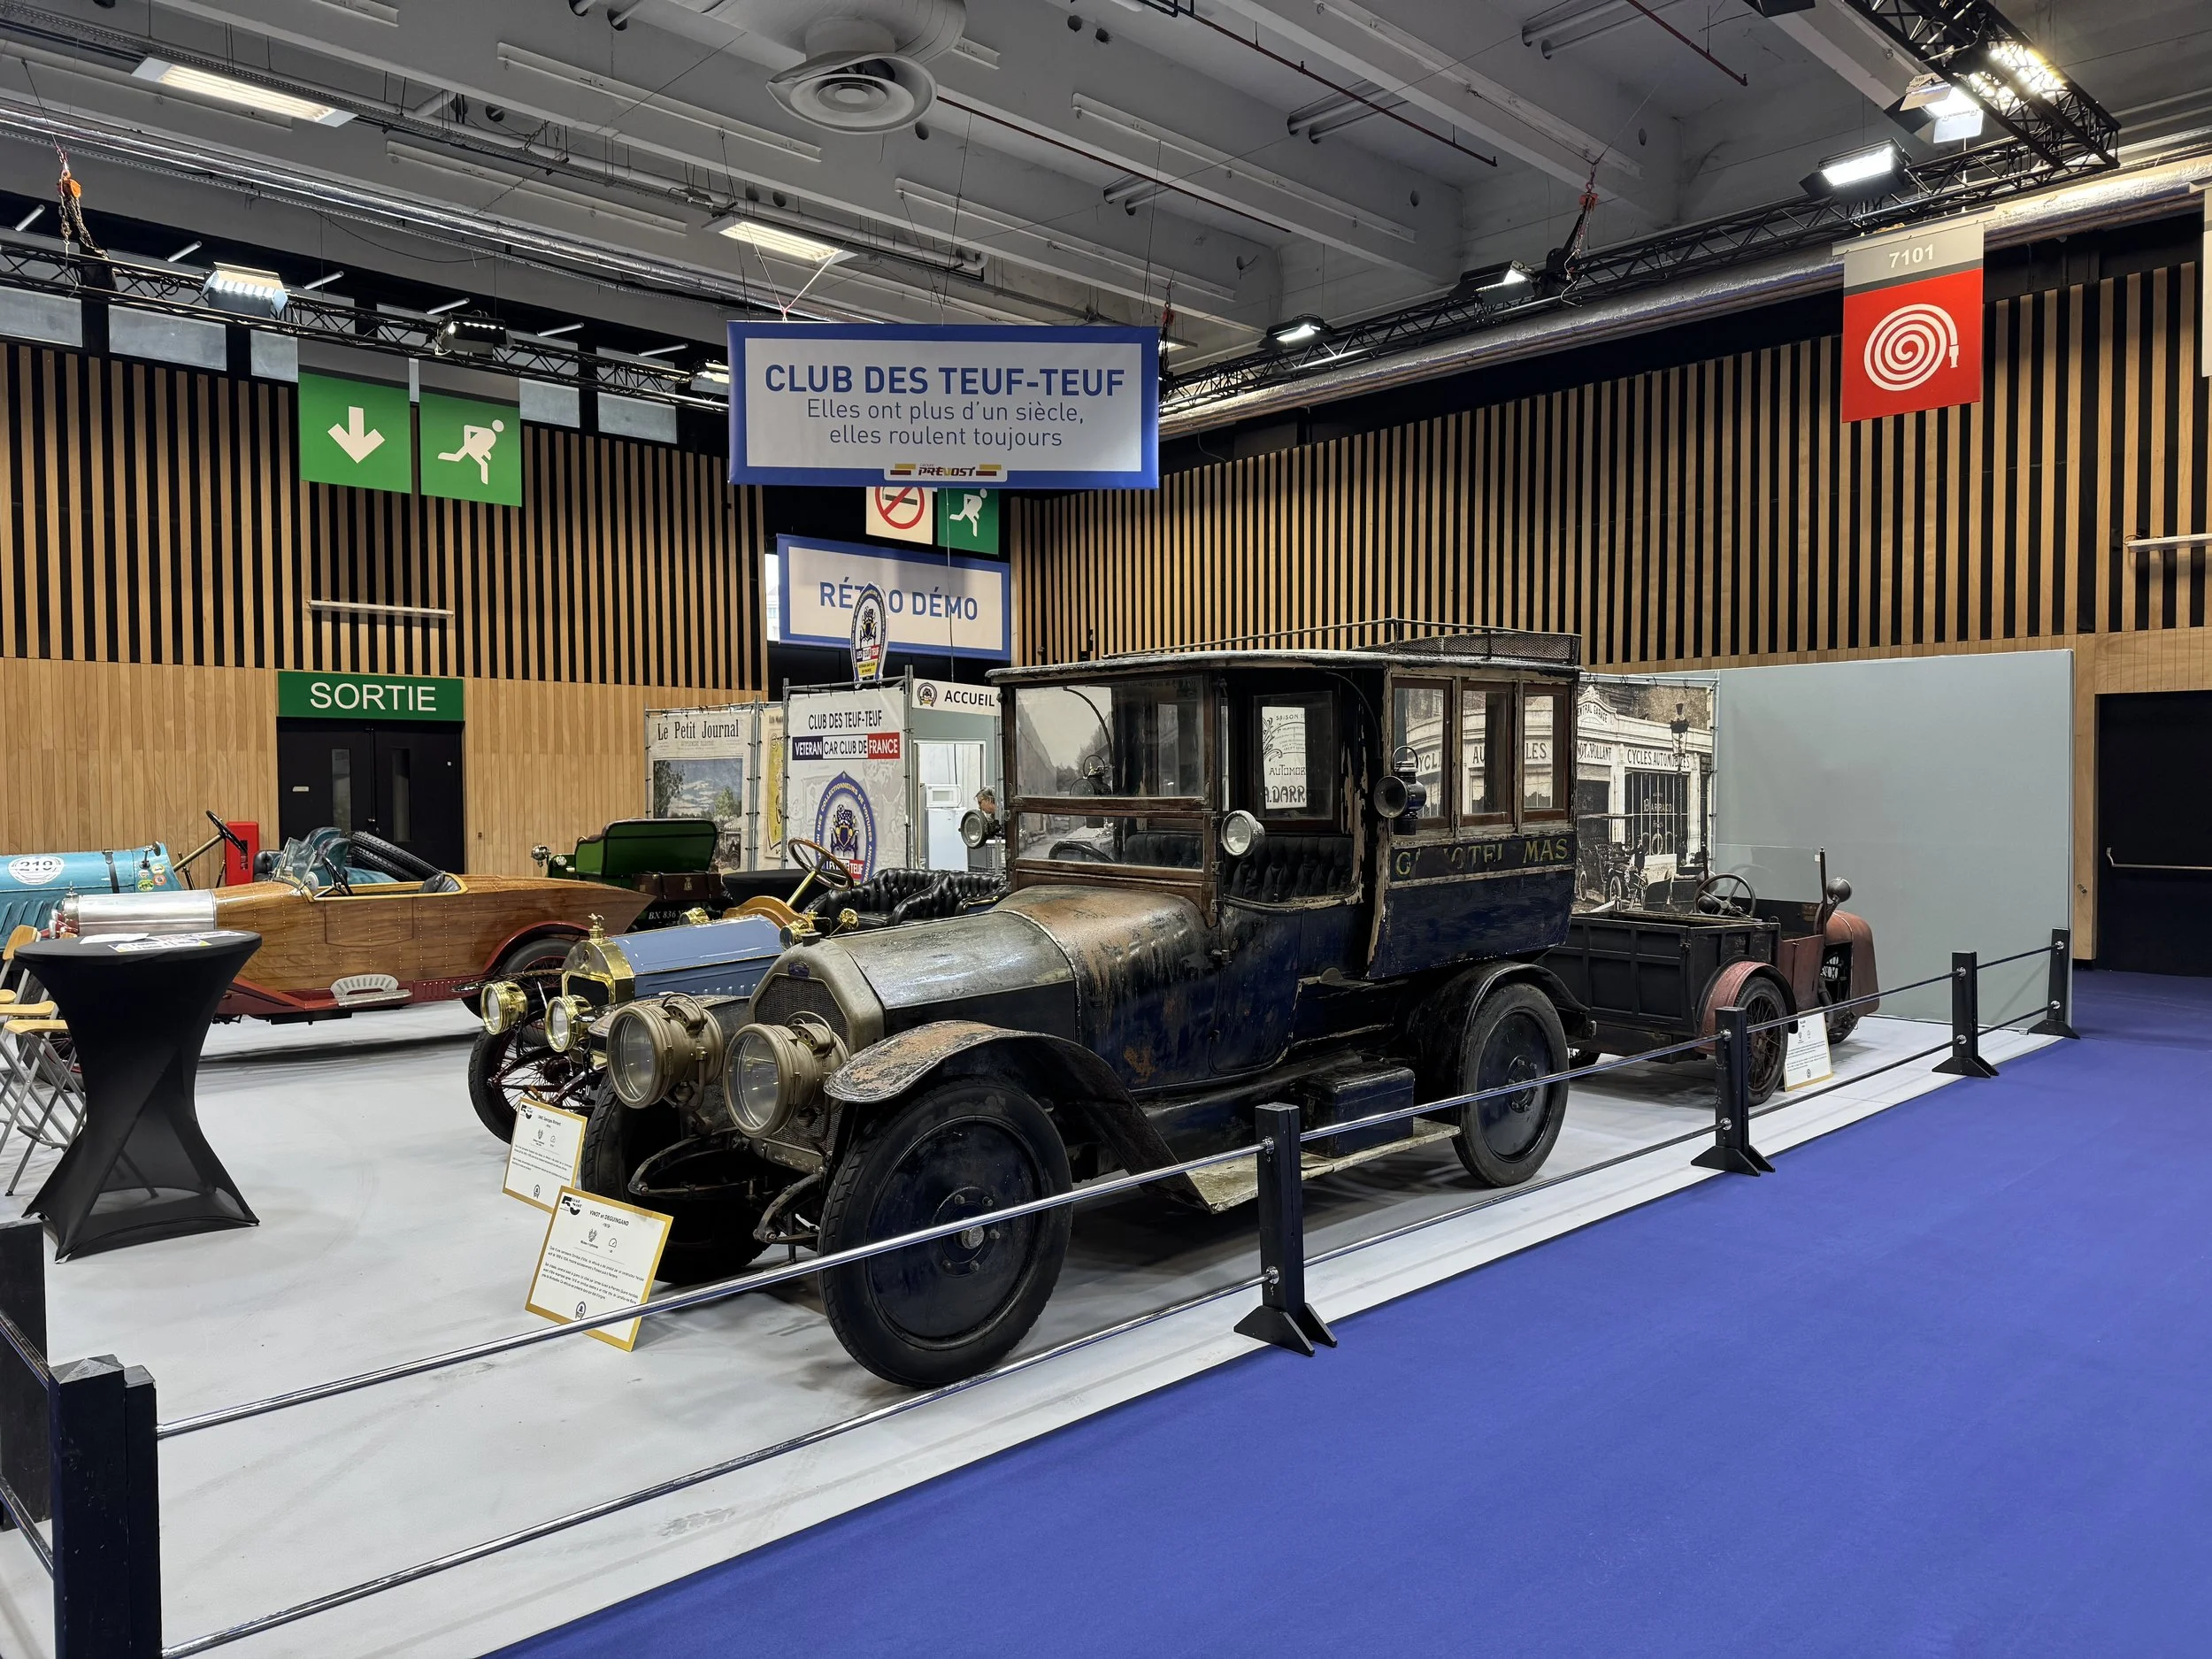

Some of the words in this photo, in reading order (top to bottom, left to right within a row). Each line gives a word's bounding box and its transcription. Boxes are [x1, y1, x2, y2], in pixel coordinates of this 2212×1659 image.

[1889, 244, 1934, 269] 7101
[765, 365, 853, 393] CLUB
[865, 366, 927, 395] DES
[938, 368, 1125, 396] TEUF-TEUF
[808, 399, 860, 419] Elles
[868, 403, 902, 419] ont
[910, 402, 955, 425] plus
[963, 401, 1009, 421] d'un
[1016, 402, 1084, 425] siècle,
[830, 426, 881, 444] elles
[890, 426, 966, 446] roulent
[973, 427, 1062, 451] toujours
[819, 577, 903, 613] RÉO
[912, 587, 978, 620] DÉMO
[310, 682, 437, 711] SORTIE
[945, 690, 995, 707] ACCUEIL
[658, 723, 669, 740] Le
[674, 721, 695, 739] Petit
[702, 718, 739, 739] Journal
[809, 714, 826, 730] CLUB
[829, 713, 842, 729] DES
[846, 710, 882, 727] TEUF-TEUF
[795, 741, 822, 756] VETERAN
[823, 740, 839, 755] CAR
[840, 740, 856, 754] CLUB
[858, 740, 867, 754] DE
[869, 738, 897, 754] FRANCE
[863, 845, 872, 883] ANCIENNE
[1522, 839, 1568, 864] MAS
[649, 911, 661, 920] BX
